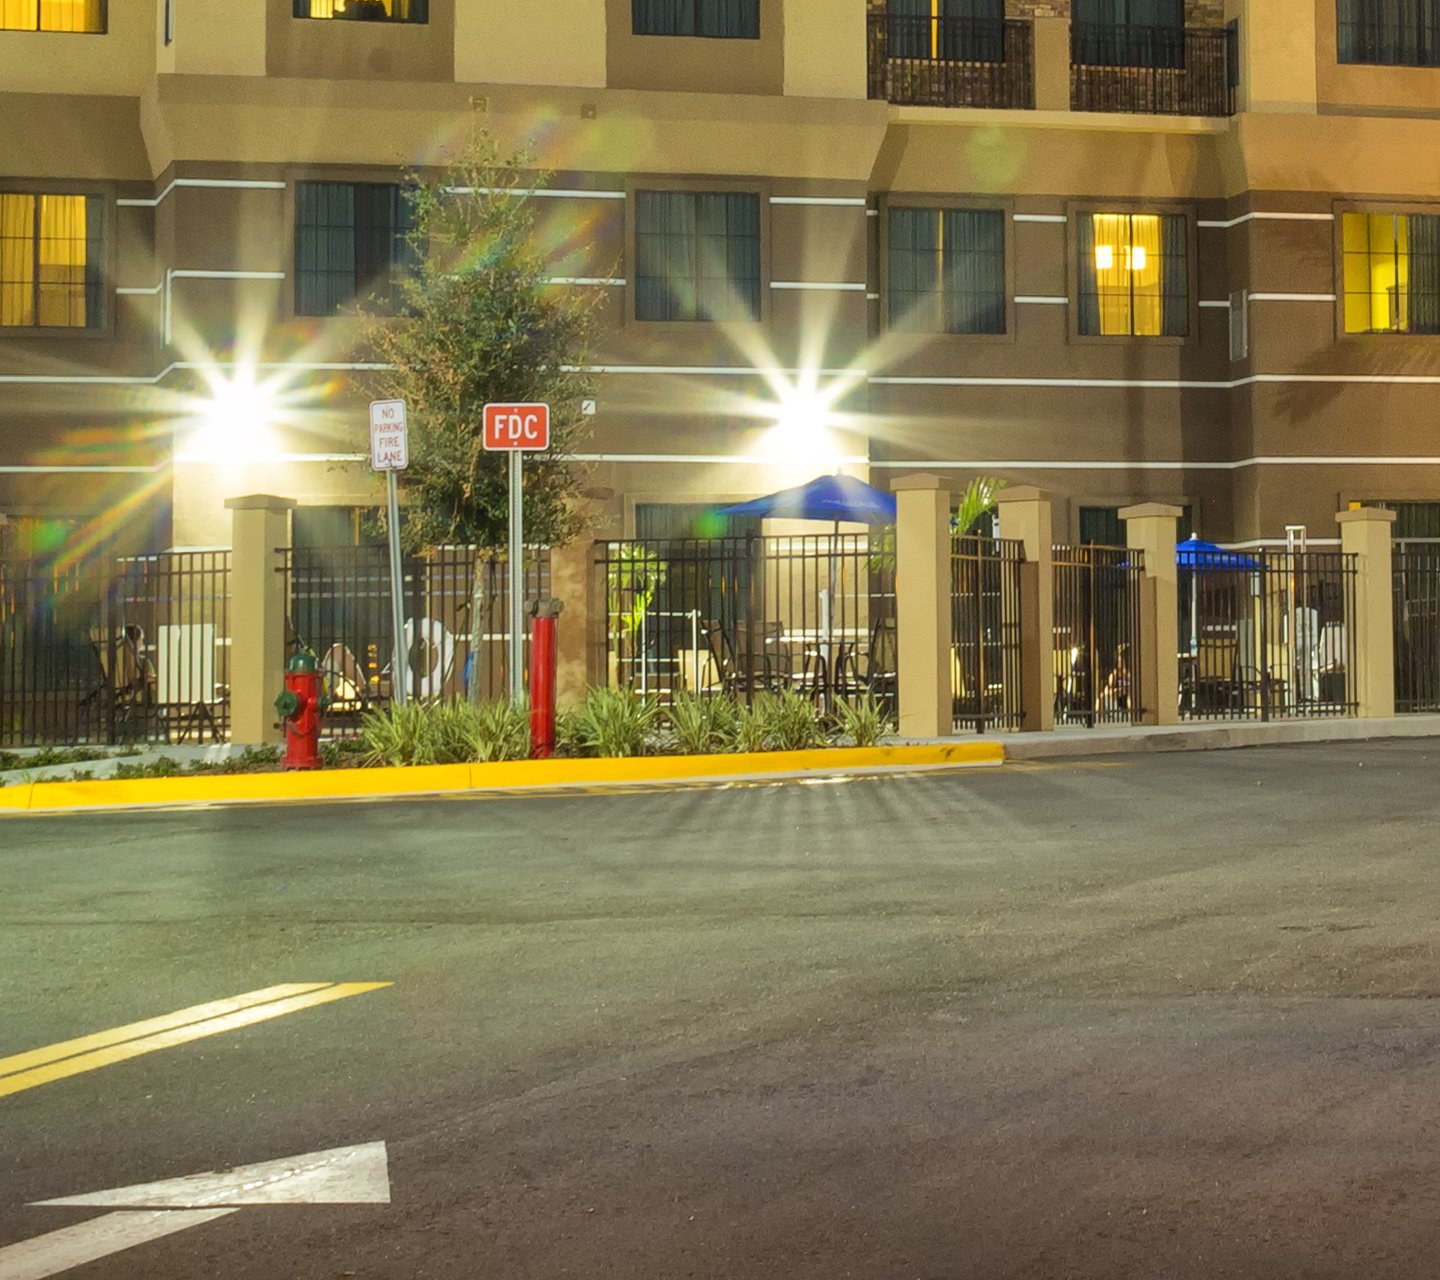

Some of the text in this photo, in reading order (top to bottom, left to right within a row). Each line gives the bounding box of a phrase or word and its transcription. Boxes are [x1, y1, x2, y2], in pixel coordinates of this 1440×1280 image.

[382, 408, 395, 419] NO
[374, 422, 403, 433] PARKING
[494, 414, 538, 440] FDC
[379, 436, 400, 448] FIRE
[378, 450, 402, 462] LANE
